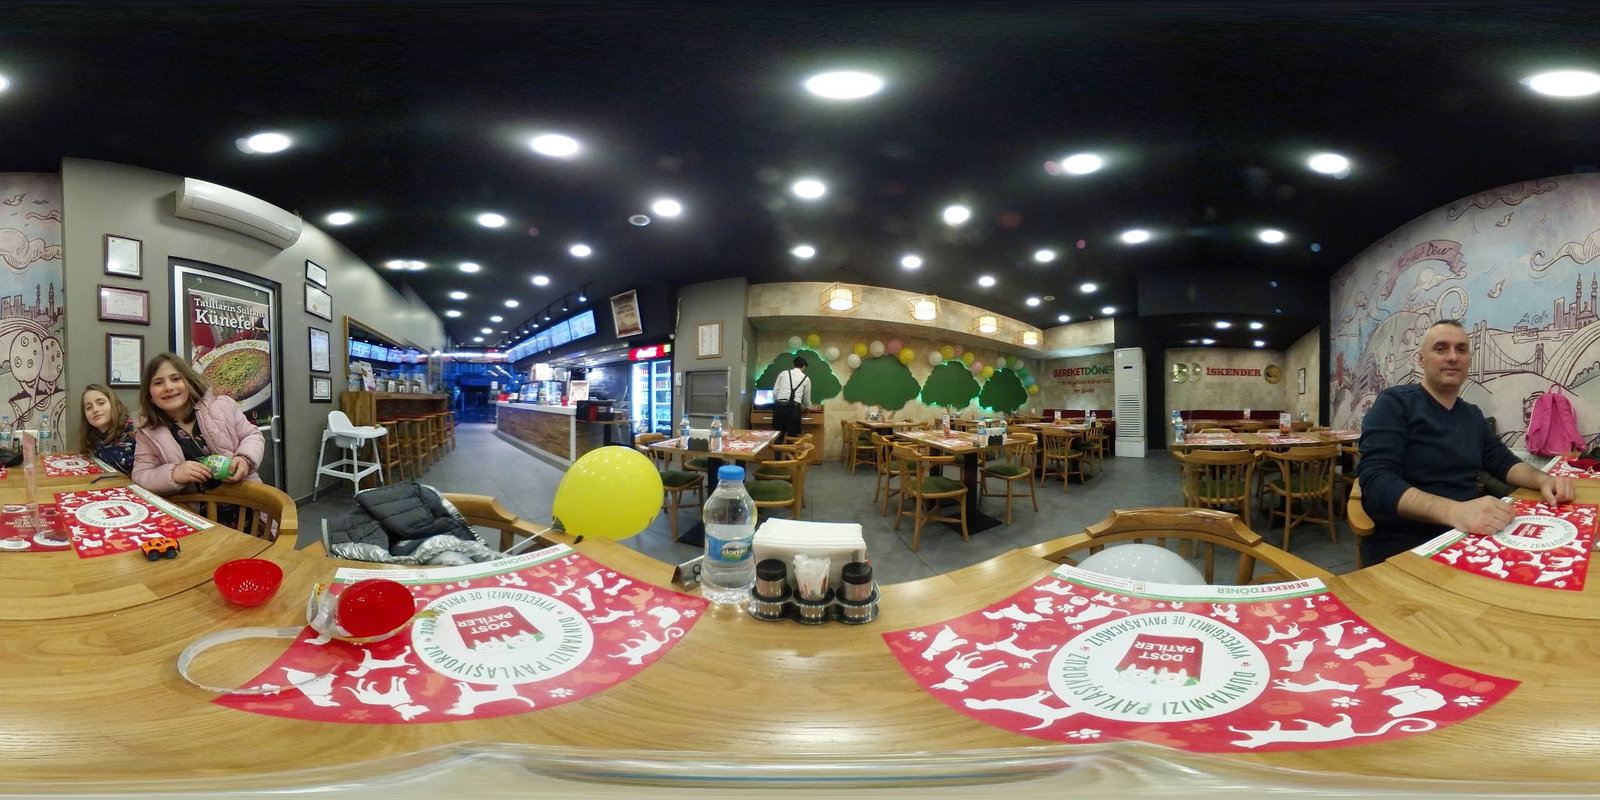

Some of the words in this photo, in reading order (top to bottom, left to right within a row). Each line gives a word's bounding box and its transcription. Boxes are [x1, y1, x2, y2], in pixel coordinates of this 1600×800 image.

[194, 308, 255, 331] Künefe!
[1206, 367, 1262, 377] İSKENDER
[1217, 580, 1309, 594] BEREKETDÖNER
[469, 592, 483, 601] DE
[456, 611, 515, 628] PATİLER
[471, 621, 512, 635] DOST
[1172, 615, 1186, 625] DE
[1085, 615, 1167, 647] PAYLAŞACAĞIZ
[1188, 616, 1251, 660] YİYECEĞİMİZİ
[546, 616, 583, 667] DÜNYAMIZI
[1134, 640, 1196, 654] PATİLER
[424, 645, 551, 679] PAYLAŞIYORUZ
[1139, 651, 1184, 662] DOST
[1062, 653, 1151, 716] PAYLAŞIYORUZ
[1162, 671, 1259, 716] DÜNYAMIZI
